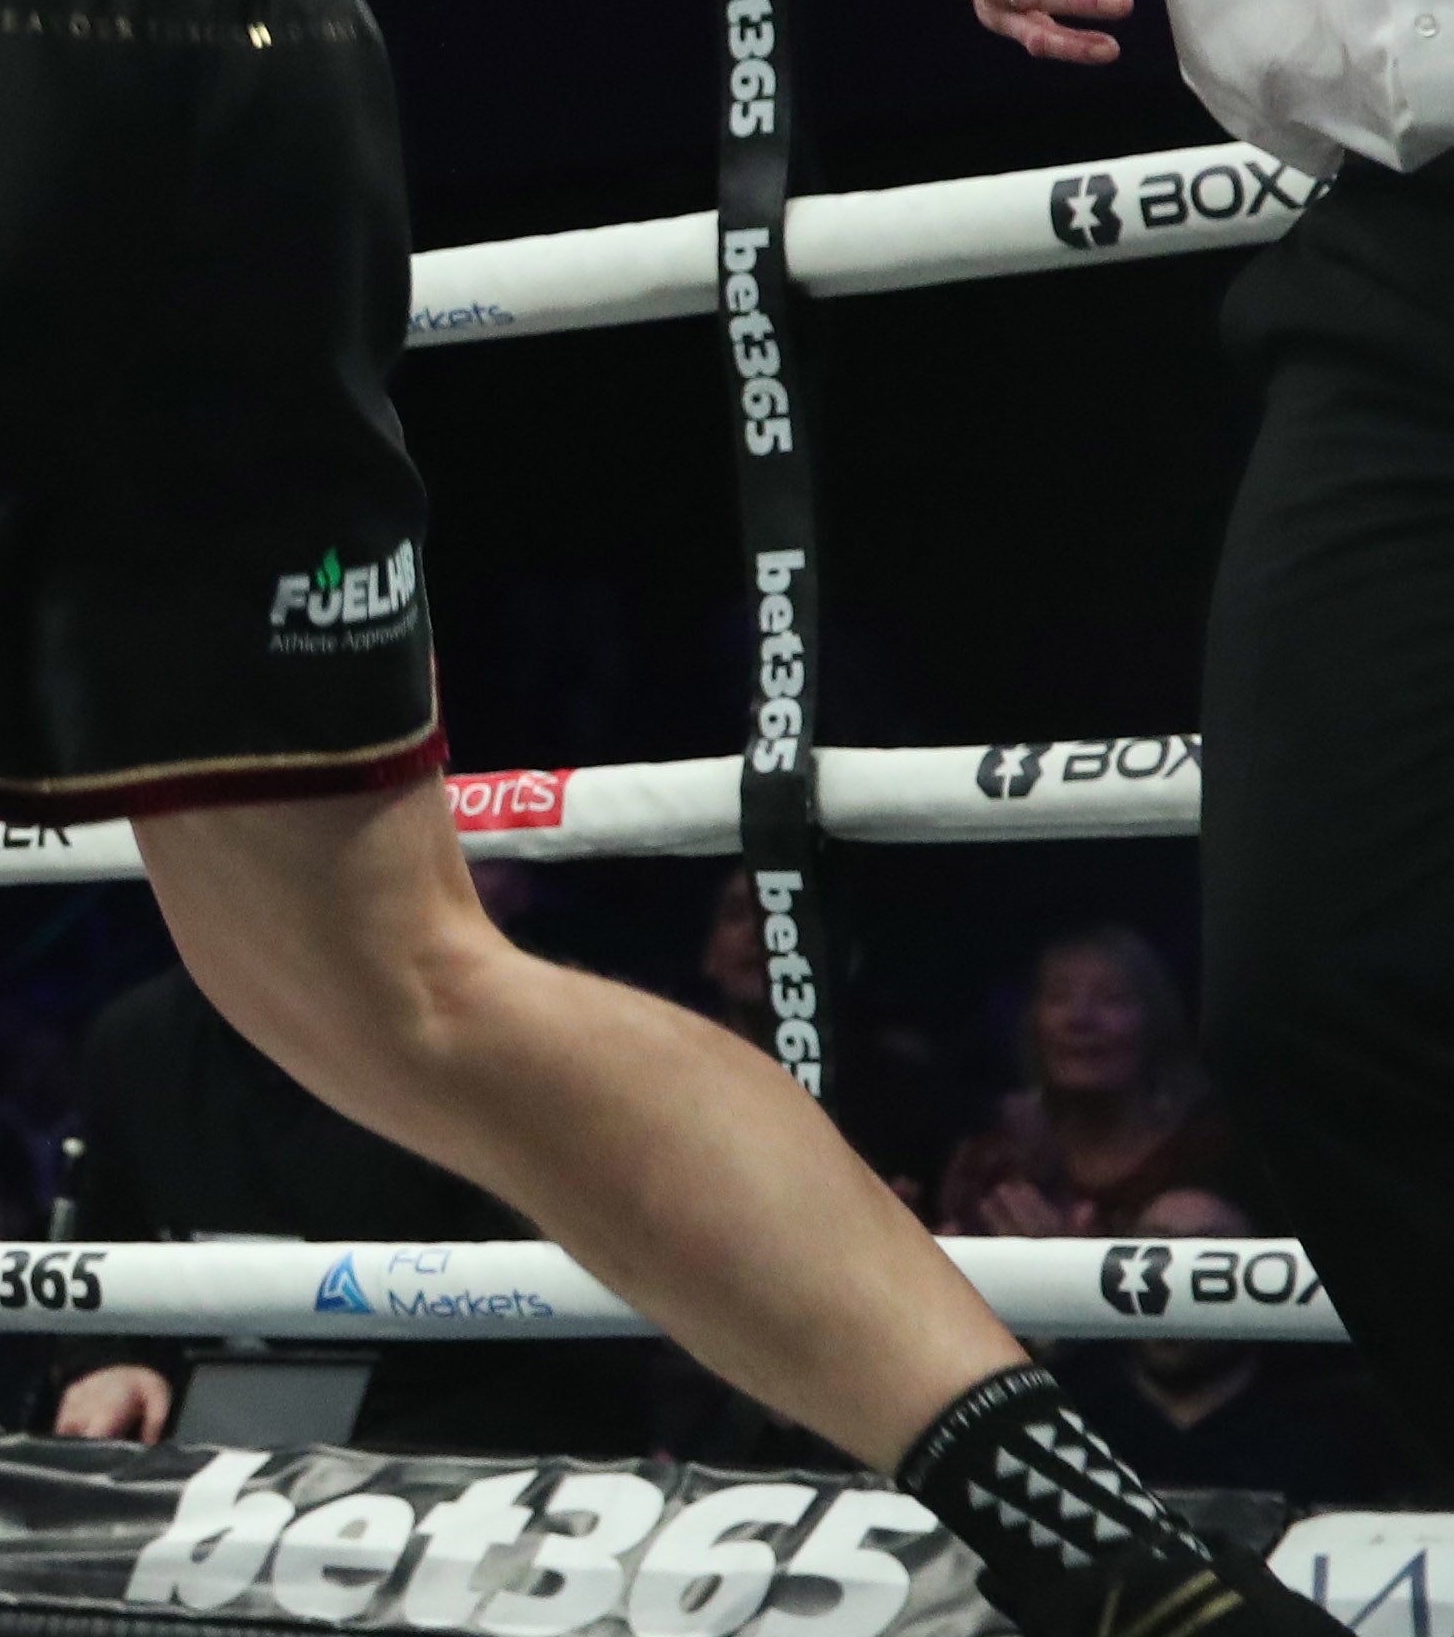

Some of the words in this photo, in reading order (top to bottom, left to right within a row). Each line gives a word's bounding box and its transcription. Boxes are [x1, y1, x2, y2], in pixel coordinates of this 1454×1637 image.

[724, 227, 793, 456] bet365
[753, 548, 805, 774] bet365
[387, 1287, 554, 1317] Markets
[388, 1248, 452, 1275] FCI
[126, 1449, 943, 1637] bet365
